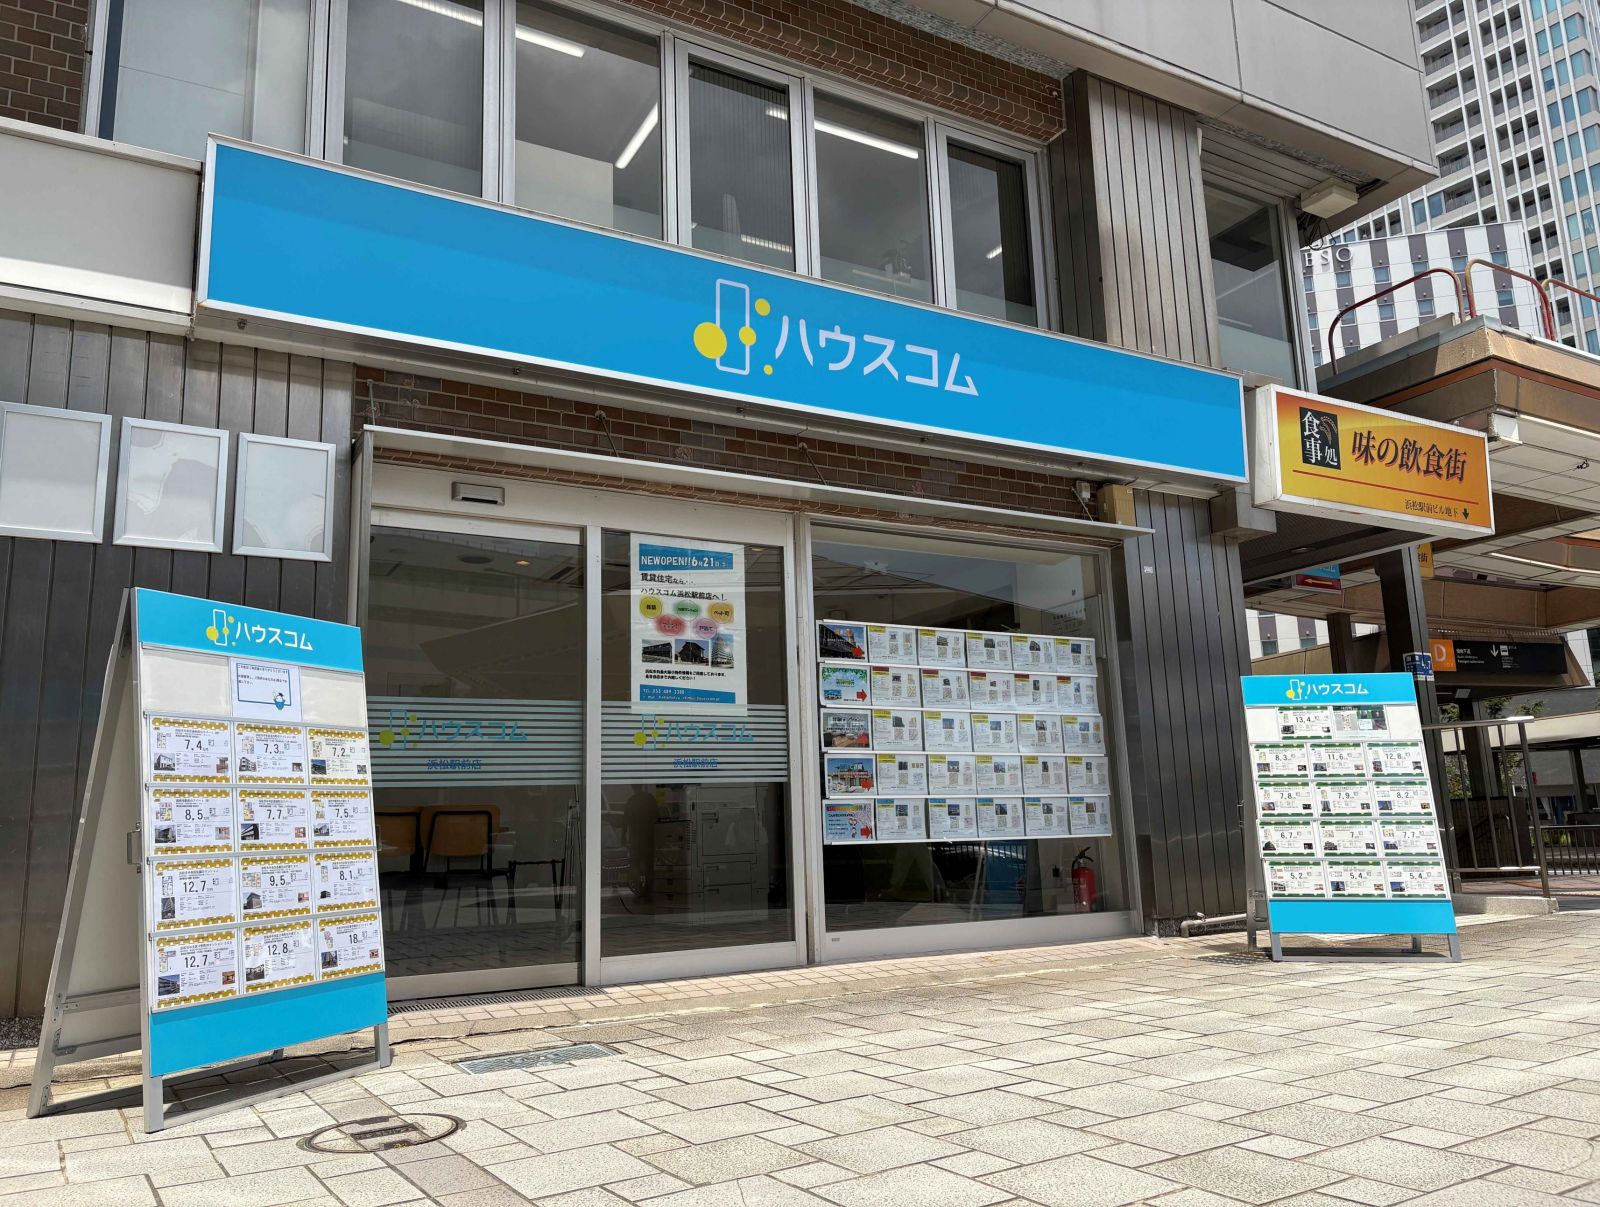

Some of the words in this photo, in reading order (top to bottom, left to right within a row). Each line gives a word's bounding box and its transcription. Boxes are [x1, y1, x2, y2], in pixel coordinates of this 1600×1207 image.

[775, 314, 980, 397] ハウスコム
[1352, 430, 1467, 483] 味の飲食街
[1404, 499, 1459, 518] 浜松駅前ビル地下
[235, 621, 314, 651] ハウスコム
[1433, 643, 1447, 662] D
[1306, 683, 1369, 695] ハウスコム
[418, 719, 528, 741] ハウスコム
[665, 722, 754, 742] ハウスコム
